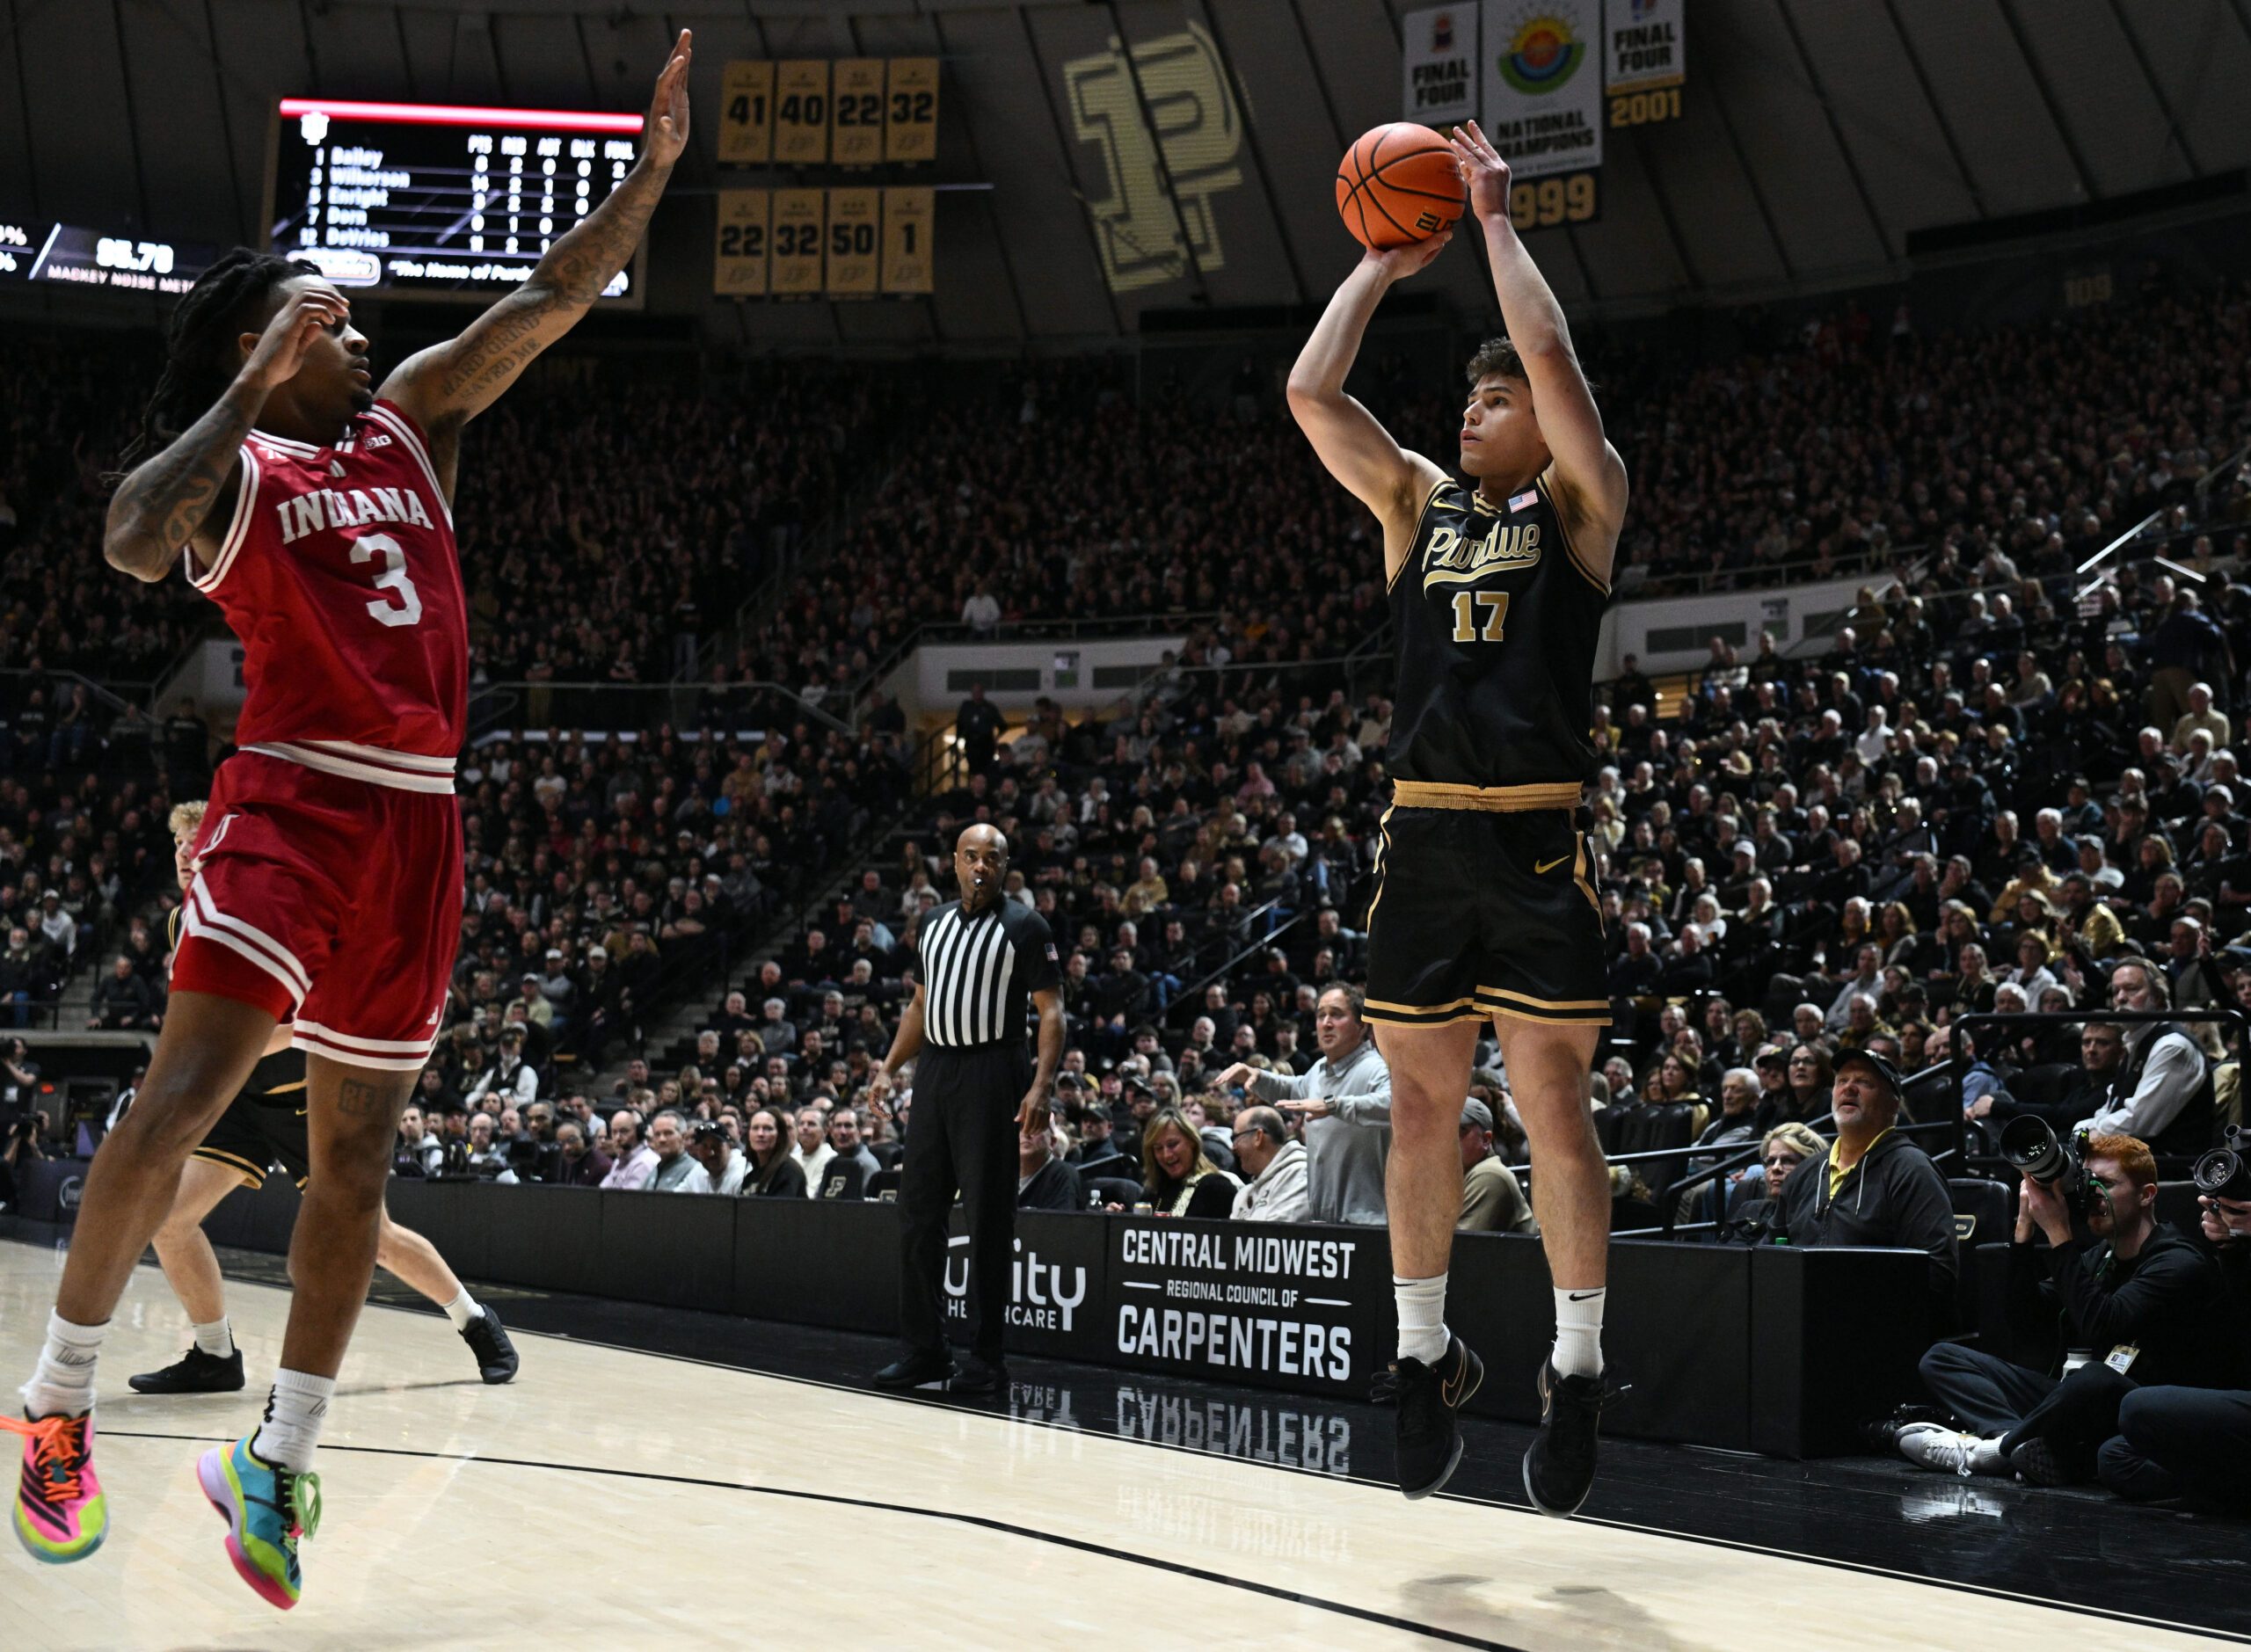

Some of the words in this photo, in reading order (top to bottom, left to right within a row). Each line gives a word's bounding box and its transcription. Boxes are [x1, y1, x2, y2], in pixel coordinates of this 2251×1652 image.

[1614, 23, 1676, 51] FINAL
[1412, 59, 1469, 85] FINAL
[1619, 47, 1672, 73] FOUR
[728, 95, 764, 125] 41
[780, 95, 824, 125] 40
[892, 92, 933, 122] 32
[1417, 82, 1466, 107] FOUR
[1609, 88, 1682, 127] 2001
[838, 95, 880, 126] 22
[1497, 109, 1584, 140] NATIONAL
[309, 207, 319, 225] 7
[1510, 174, 1597, 230] 999
[720, 225, 763, 256] 22
[776, 224, 820, 256] 32
[832, 223, 874, 255] 50
[902, 223, 915, 253] 1
[47, 265, 108, 284] MACKEY
[111, 271, 157, 290] NOISE
[426, 263, 470, 279] Home
[471, 265, 492, 280] of
[276, 487, 434, 545] INDIANA
[1422, 520, 1541, 576] Purdue
[349, 533, 422, 627] 3
[1452, 591, 1510, 643] 17
[1122, 1228, 1227, 1270] CENTRAL
[1235, 1235, 1356, 1279] MIDWEST
[943, 1235, 1087, 1331] uity
[1167, 1279, 1223, 1301] REGIONAL
[1226, 1284, 1278, 1306] COUNCIL
[1281, 1289, 1298, 1308] OF
[1118, 1304, 1351, 1381] CARPENTERS
